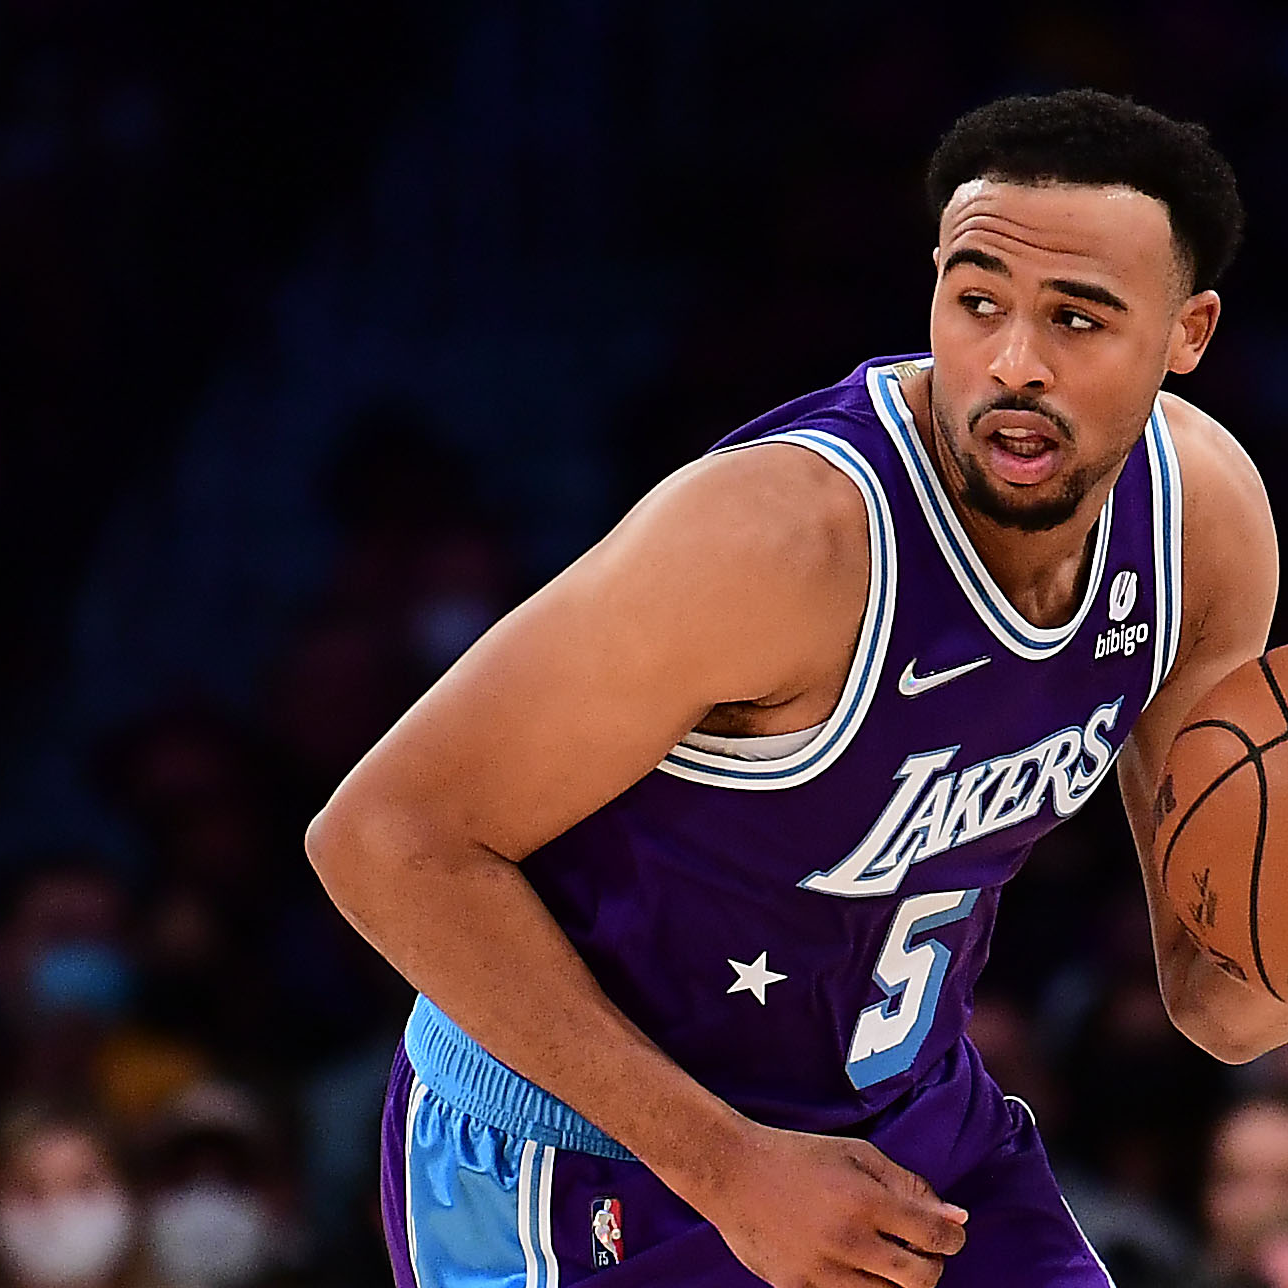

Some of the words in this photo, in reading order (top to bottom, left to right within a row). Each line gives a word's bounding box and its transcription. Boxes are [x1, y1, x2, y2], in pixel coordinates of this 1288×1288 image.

[1094, 623, 1149, 660] bibigo
[797, 696, 1124, 897] LAKERS
[845, 888, 981, 1091] 5
